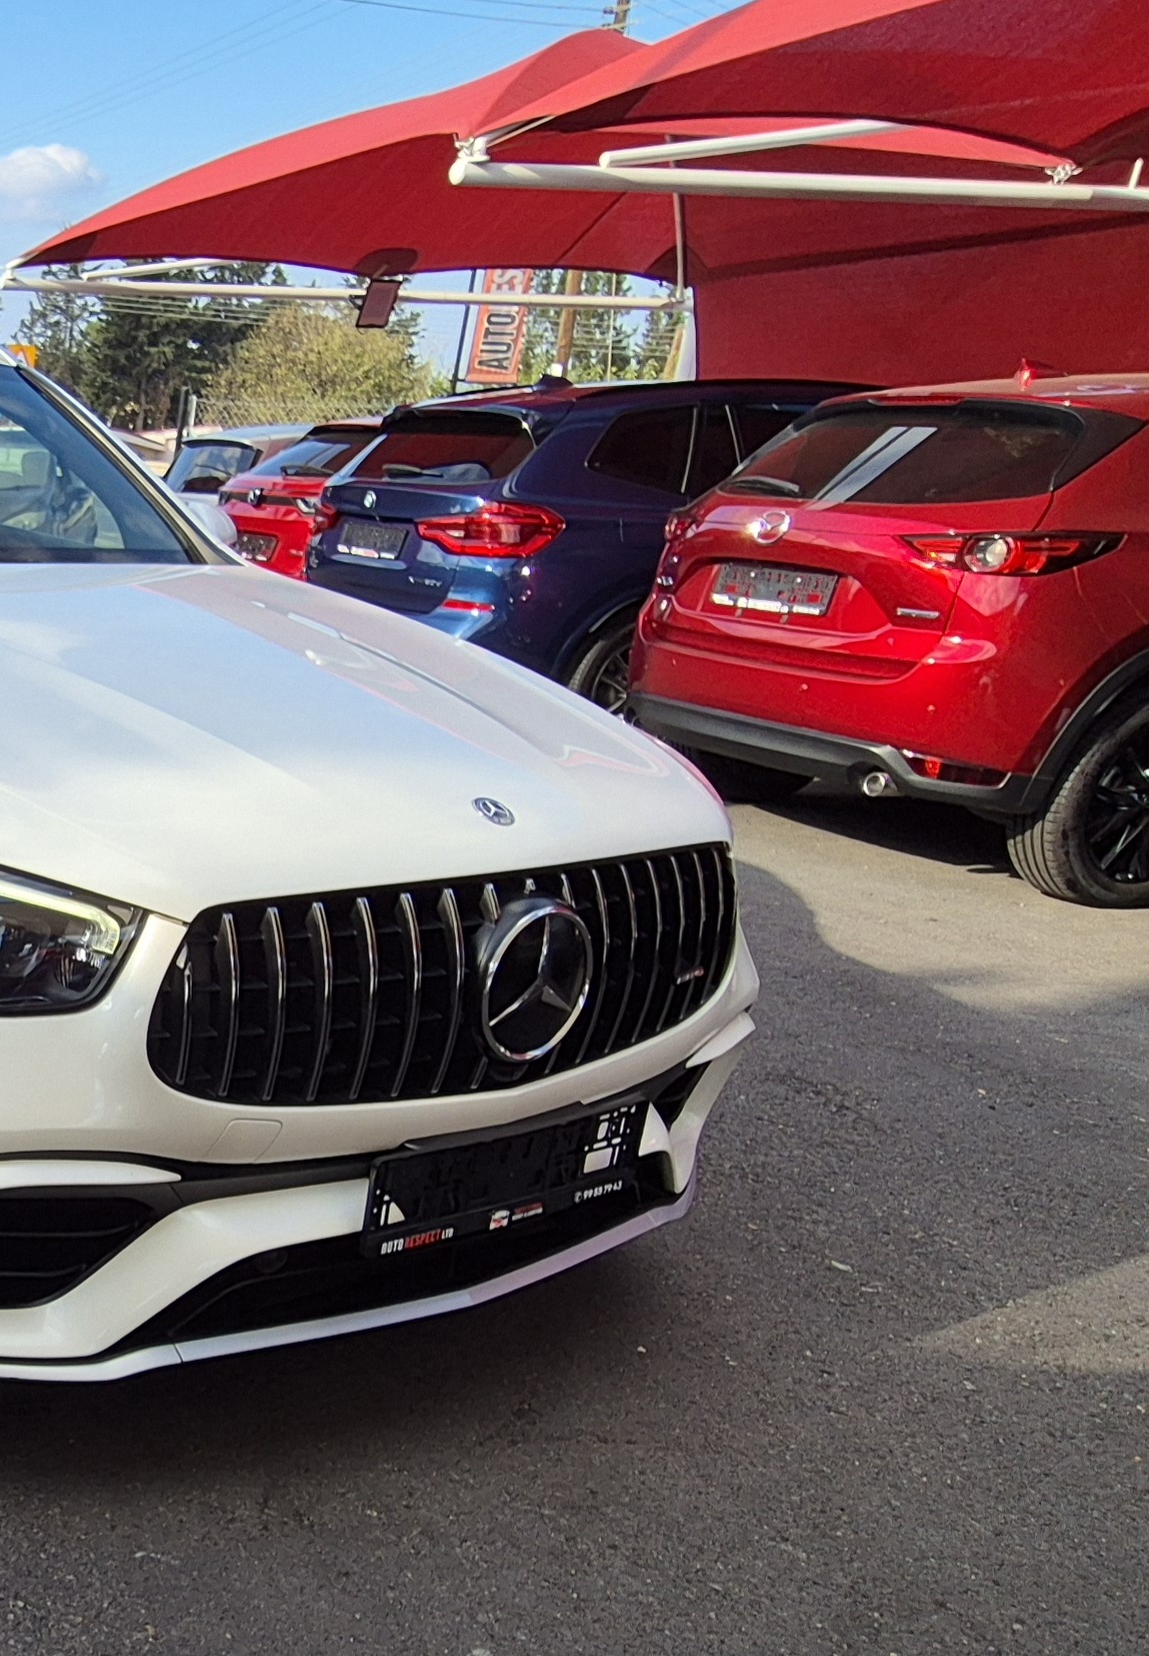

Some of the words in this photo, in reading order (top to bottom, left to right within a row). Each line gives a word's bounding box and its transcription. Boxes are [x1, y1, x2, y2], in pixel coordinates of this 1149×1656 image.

[476, 311, 519, 371] AUTO
[380, 1238, 404, 1255] AUTO
[404, 1228, 443, 1249] RESPECT
[441, 1228, 454, 1240] LTD
